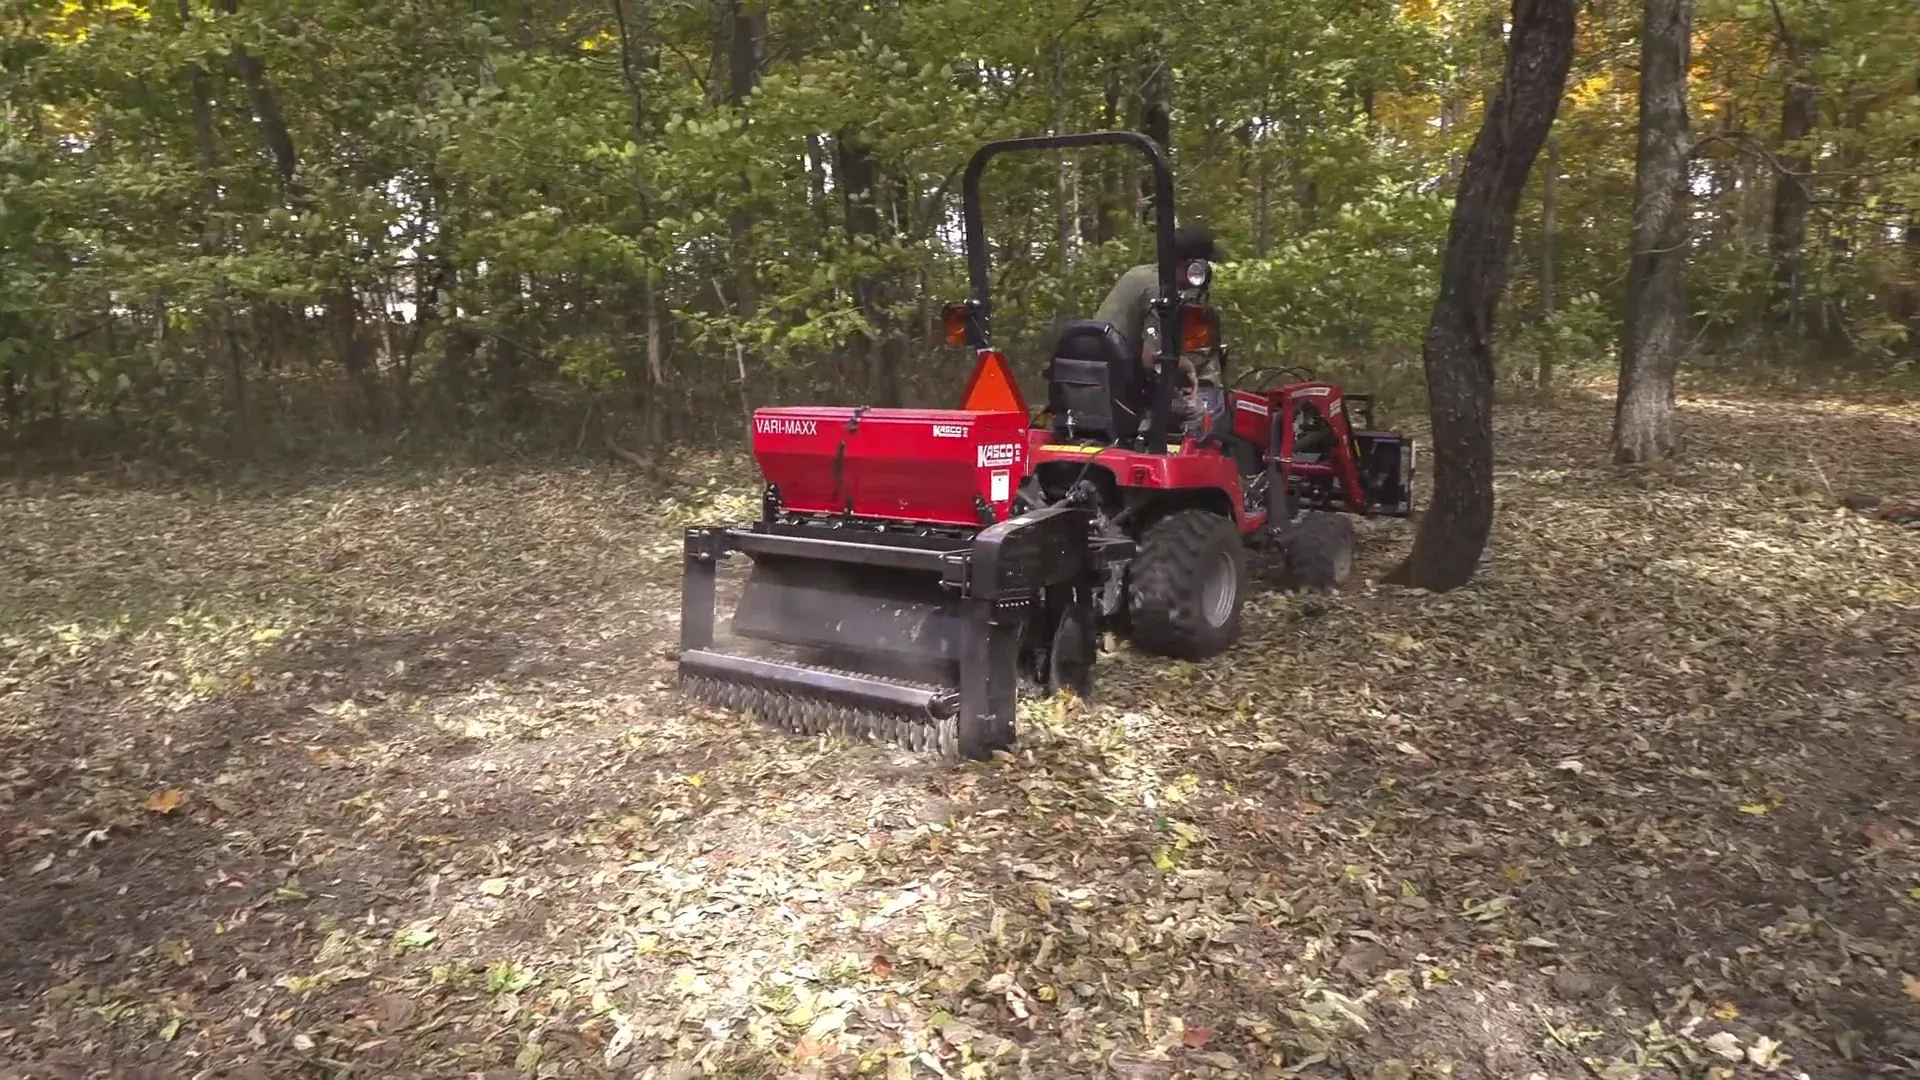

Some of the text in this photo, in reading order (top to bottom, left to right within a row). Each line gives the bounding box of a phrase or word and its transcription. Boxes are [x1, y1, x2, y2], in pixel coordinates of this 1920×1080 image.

[755, 419, 817, 435] VARI-MAXX
[932, 425, 962, 437] KASCO
[977, 444, 1014, 467] KASCO
